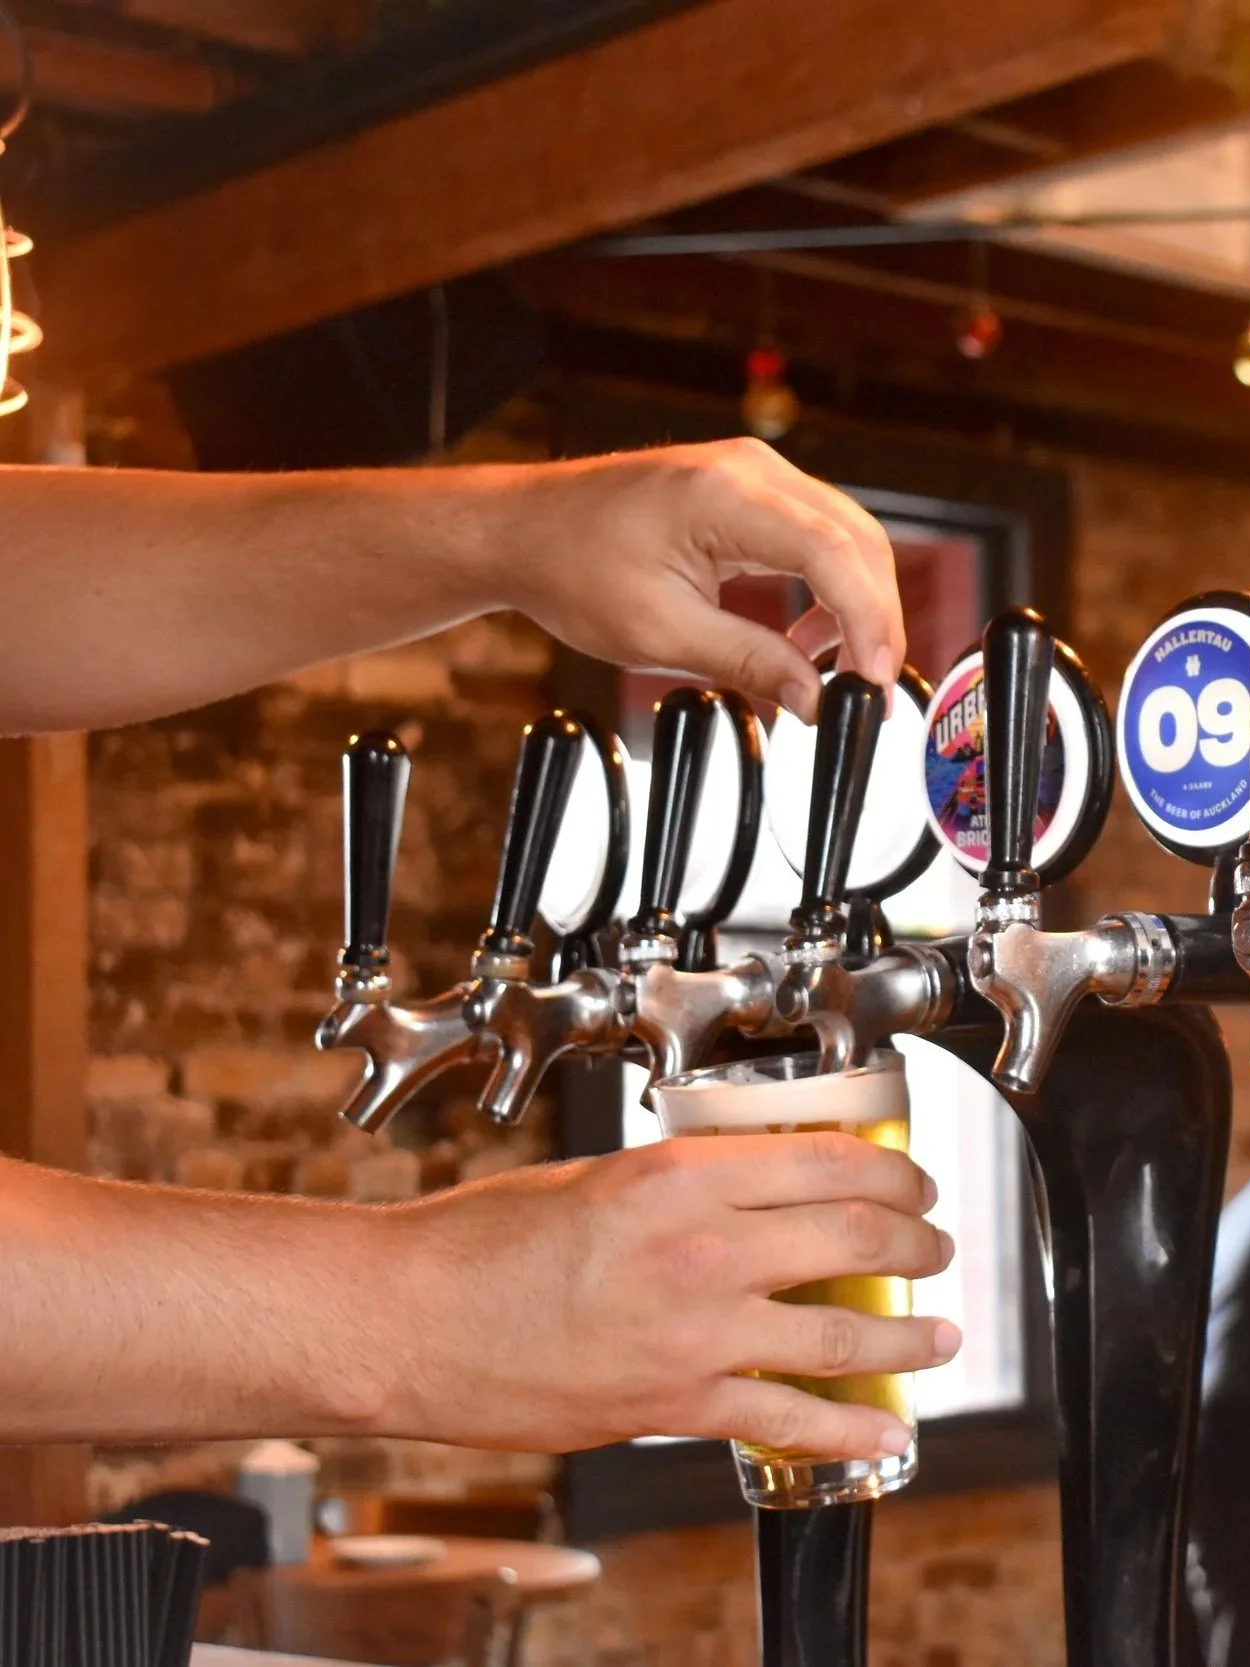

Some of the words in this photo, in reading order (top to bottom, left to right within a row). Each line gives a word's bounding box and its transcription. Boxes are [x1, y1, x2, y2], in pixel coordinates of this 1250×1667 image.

[1154, 629, 1233, 663] HALLERTAU
[1149, 788, 1166, 807] THE
[1165, 803, 1188, 818] BEER
[1190, 809, 1202, 819] OF
[1203, 779, 1248, 818] AUCKLAND
